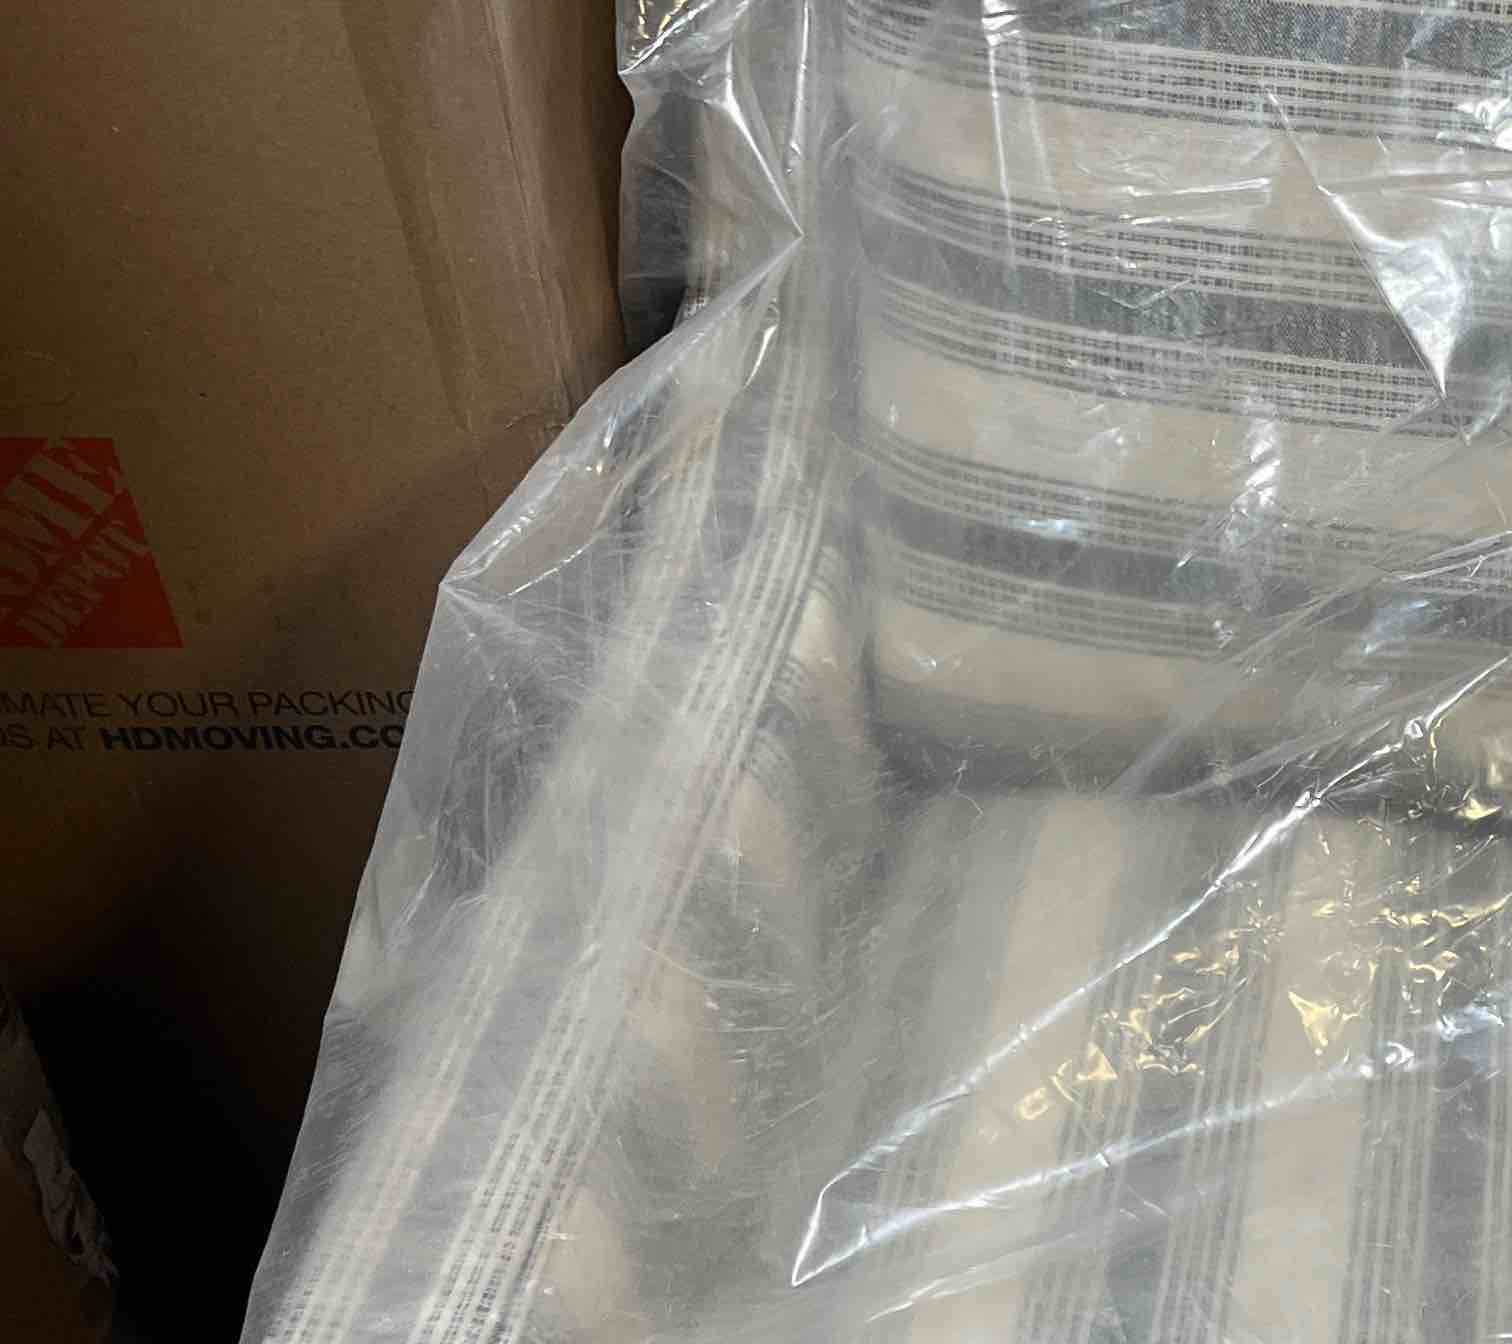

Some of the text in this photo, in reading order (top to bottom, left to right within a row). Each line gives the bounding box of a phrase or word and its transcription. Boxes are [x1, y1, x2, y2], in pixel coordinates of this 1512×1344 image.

[16, 520, 152, 649] DEPOT
[116, 691, 242, 718] YOUR
[48, 724, 88, 751] AT
